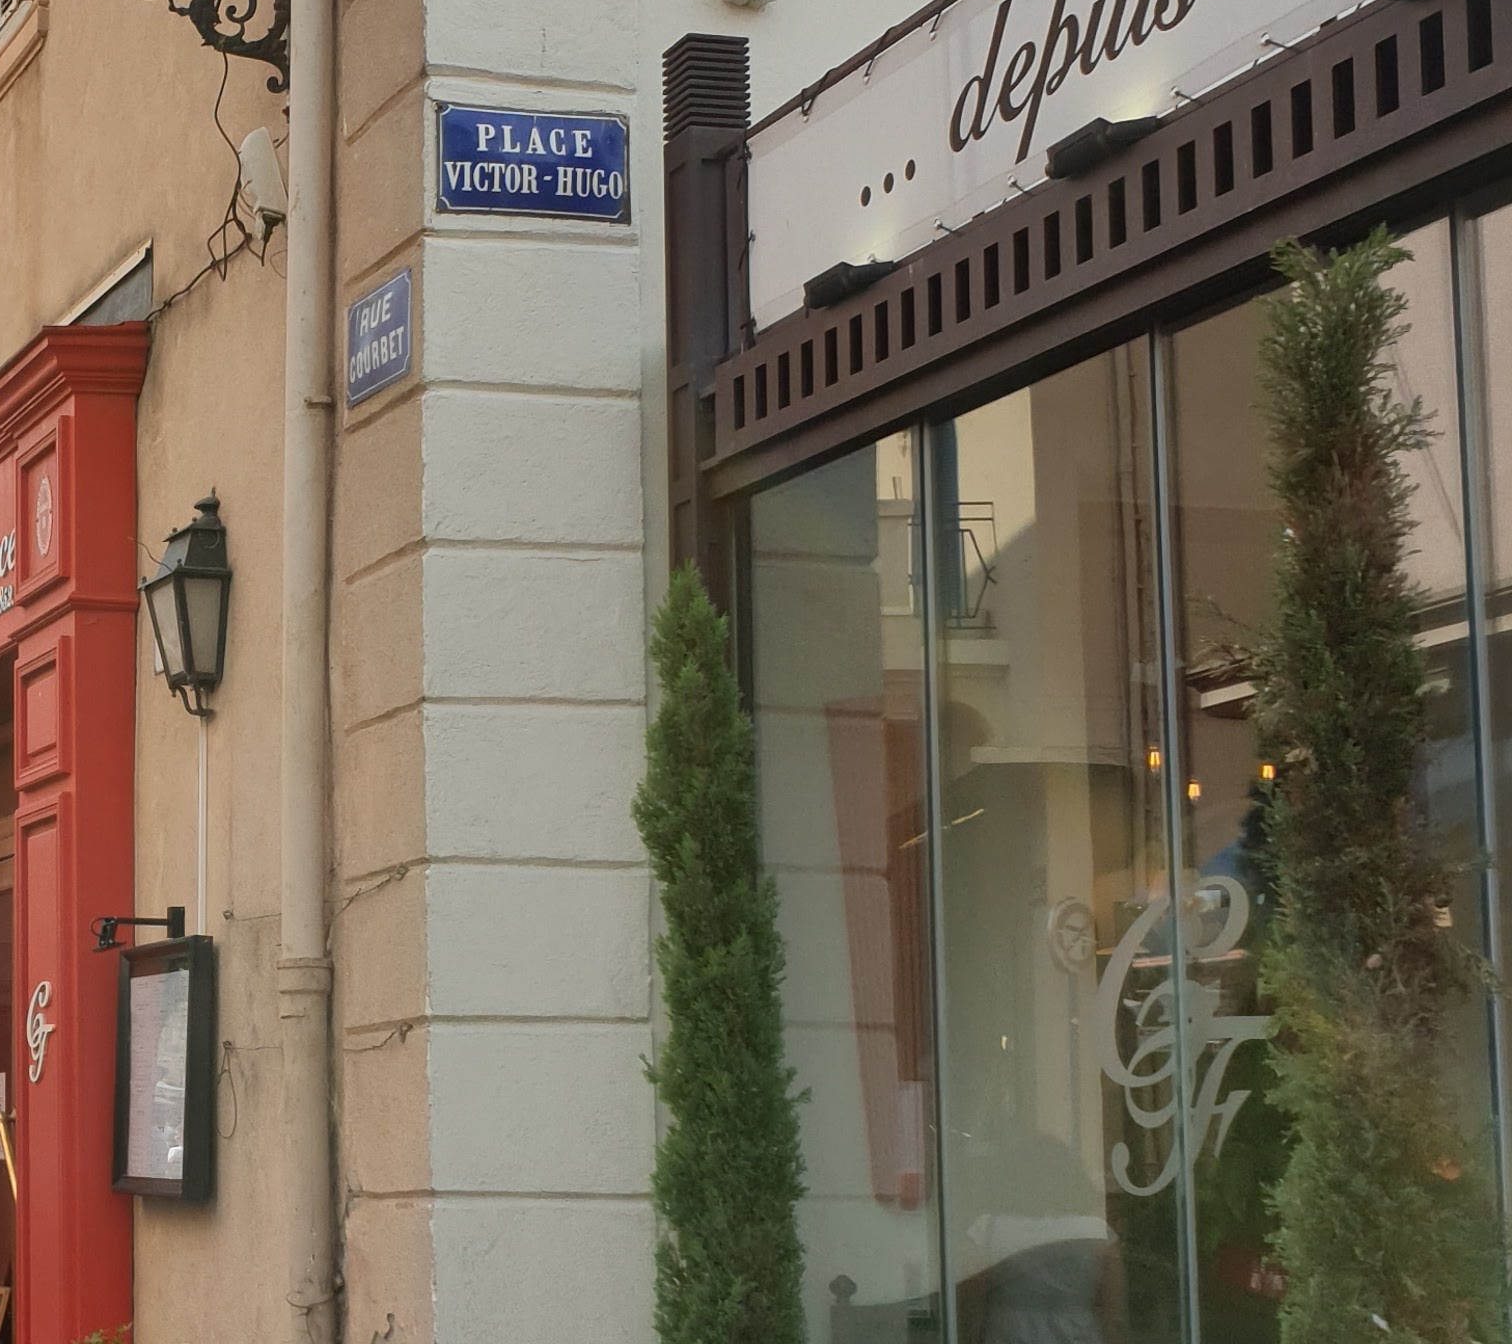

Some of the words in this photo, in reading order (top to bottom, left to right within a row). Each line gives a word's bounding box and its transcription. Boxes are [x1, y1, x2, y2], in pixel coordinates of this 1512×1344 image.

[476, 123, 593, 158] PLACE
[359, 291, 393, 337] RUE
[349, 325, 405, 384] COURBET
